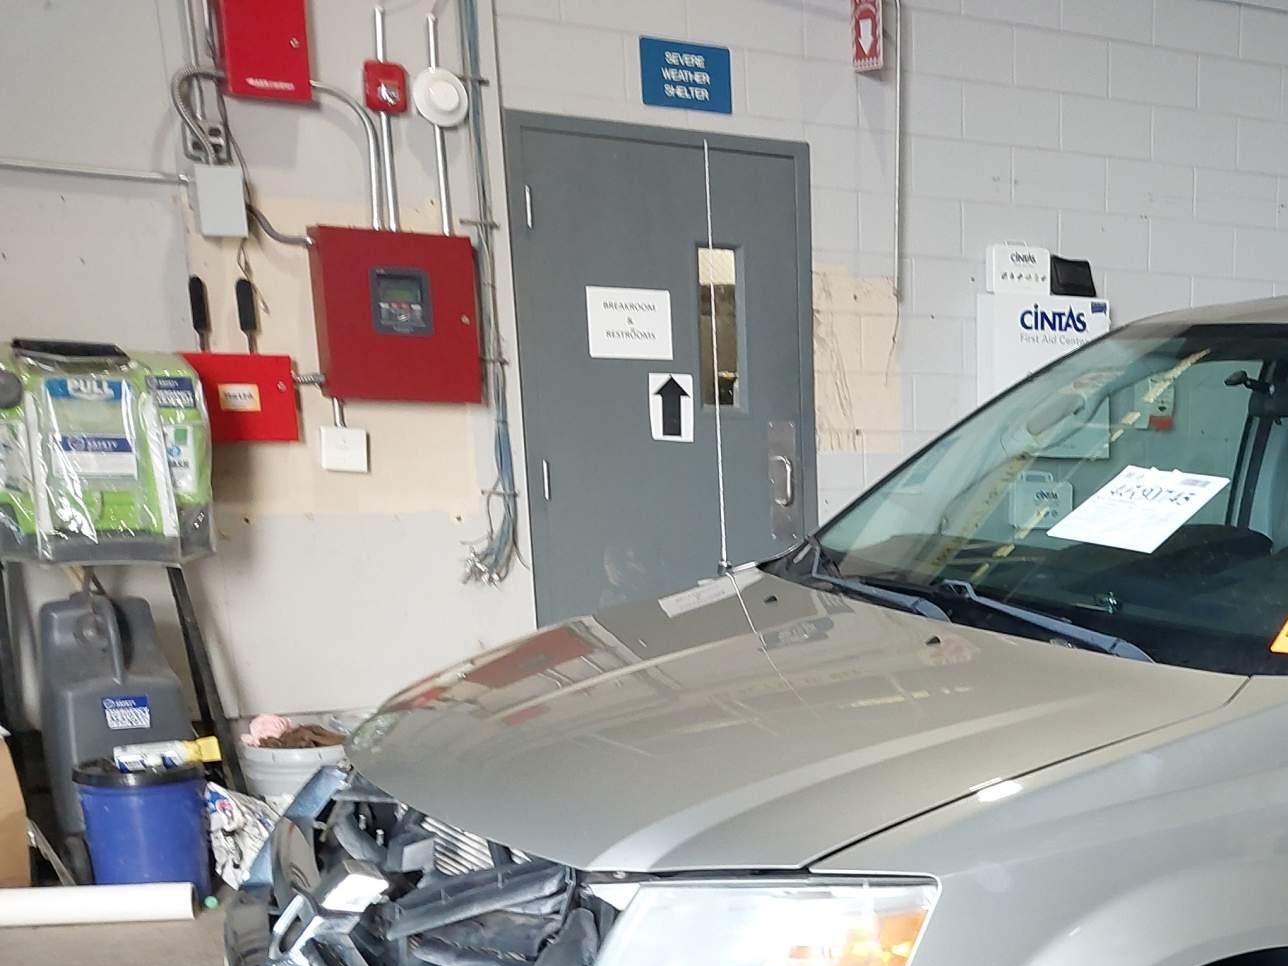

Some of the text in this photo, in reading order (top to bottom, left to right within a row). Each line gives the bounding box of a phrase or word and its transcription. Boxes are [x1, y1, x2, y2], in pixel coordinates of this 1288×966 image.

[664, 51, 705, 69] SEVERE
[661, 67, 711, 85] WEATHER
[664, 84, 710, 101] SHELTER
[602, 301, 656, 312] BREAKROOM
[627, 316, 635, 325] &
[1020, 303, 1088, 333] CINTAS
[605, 329, 657, 340] RESTROOMS
[1020, 334, 1039, 344] First
[1042, 334, 1057, 345] Aid
